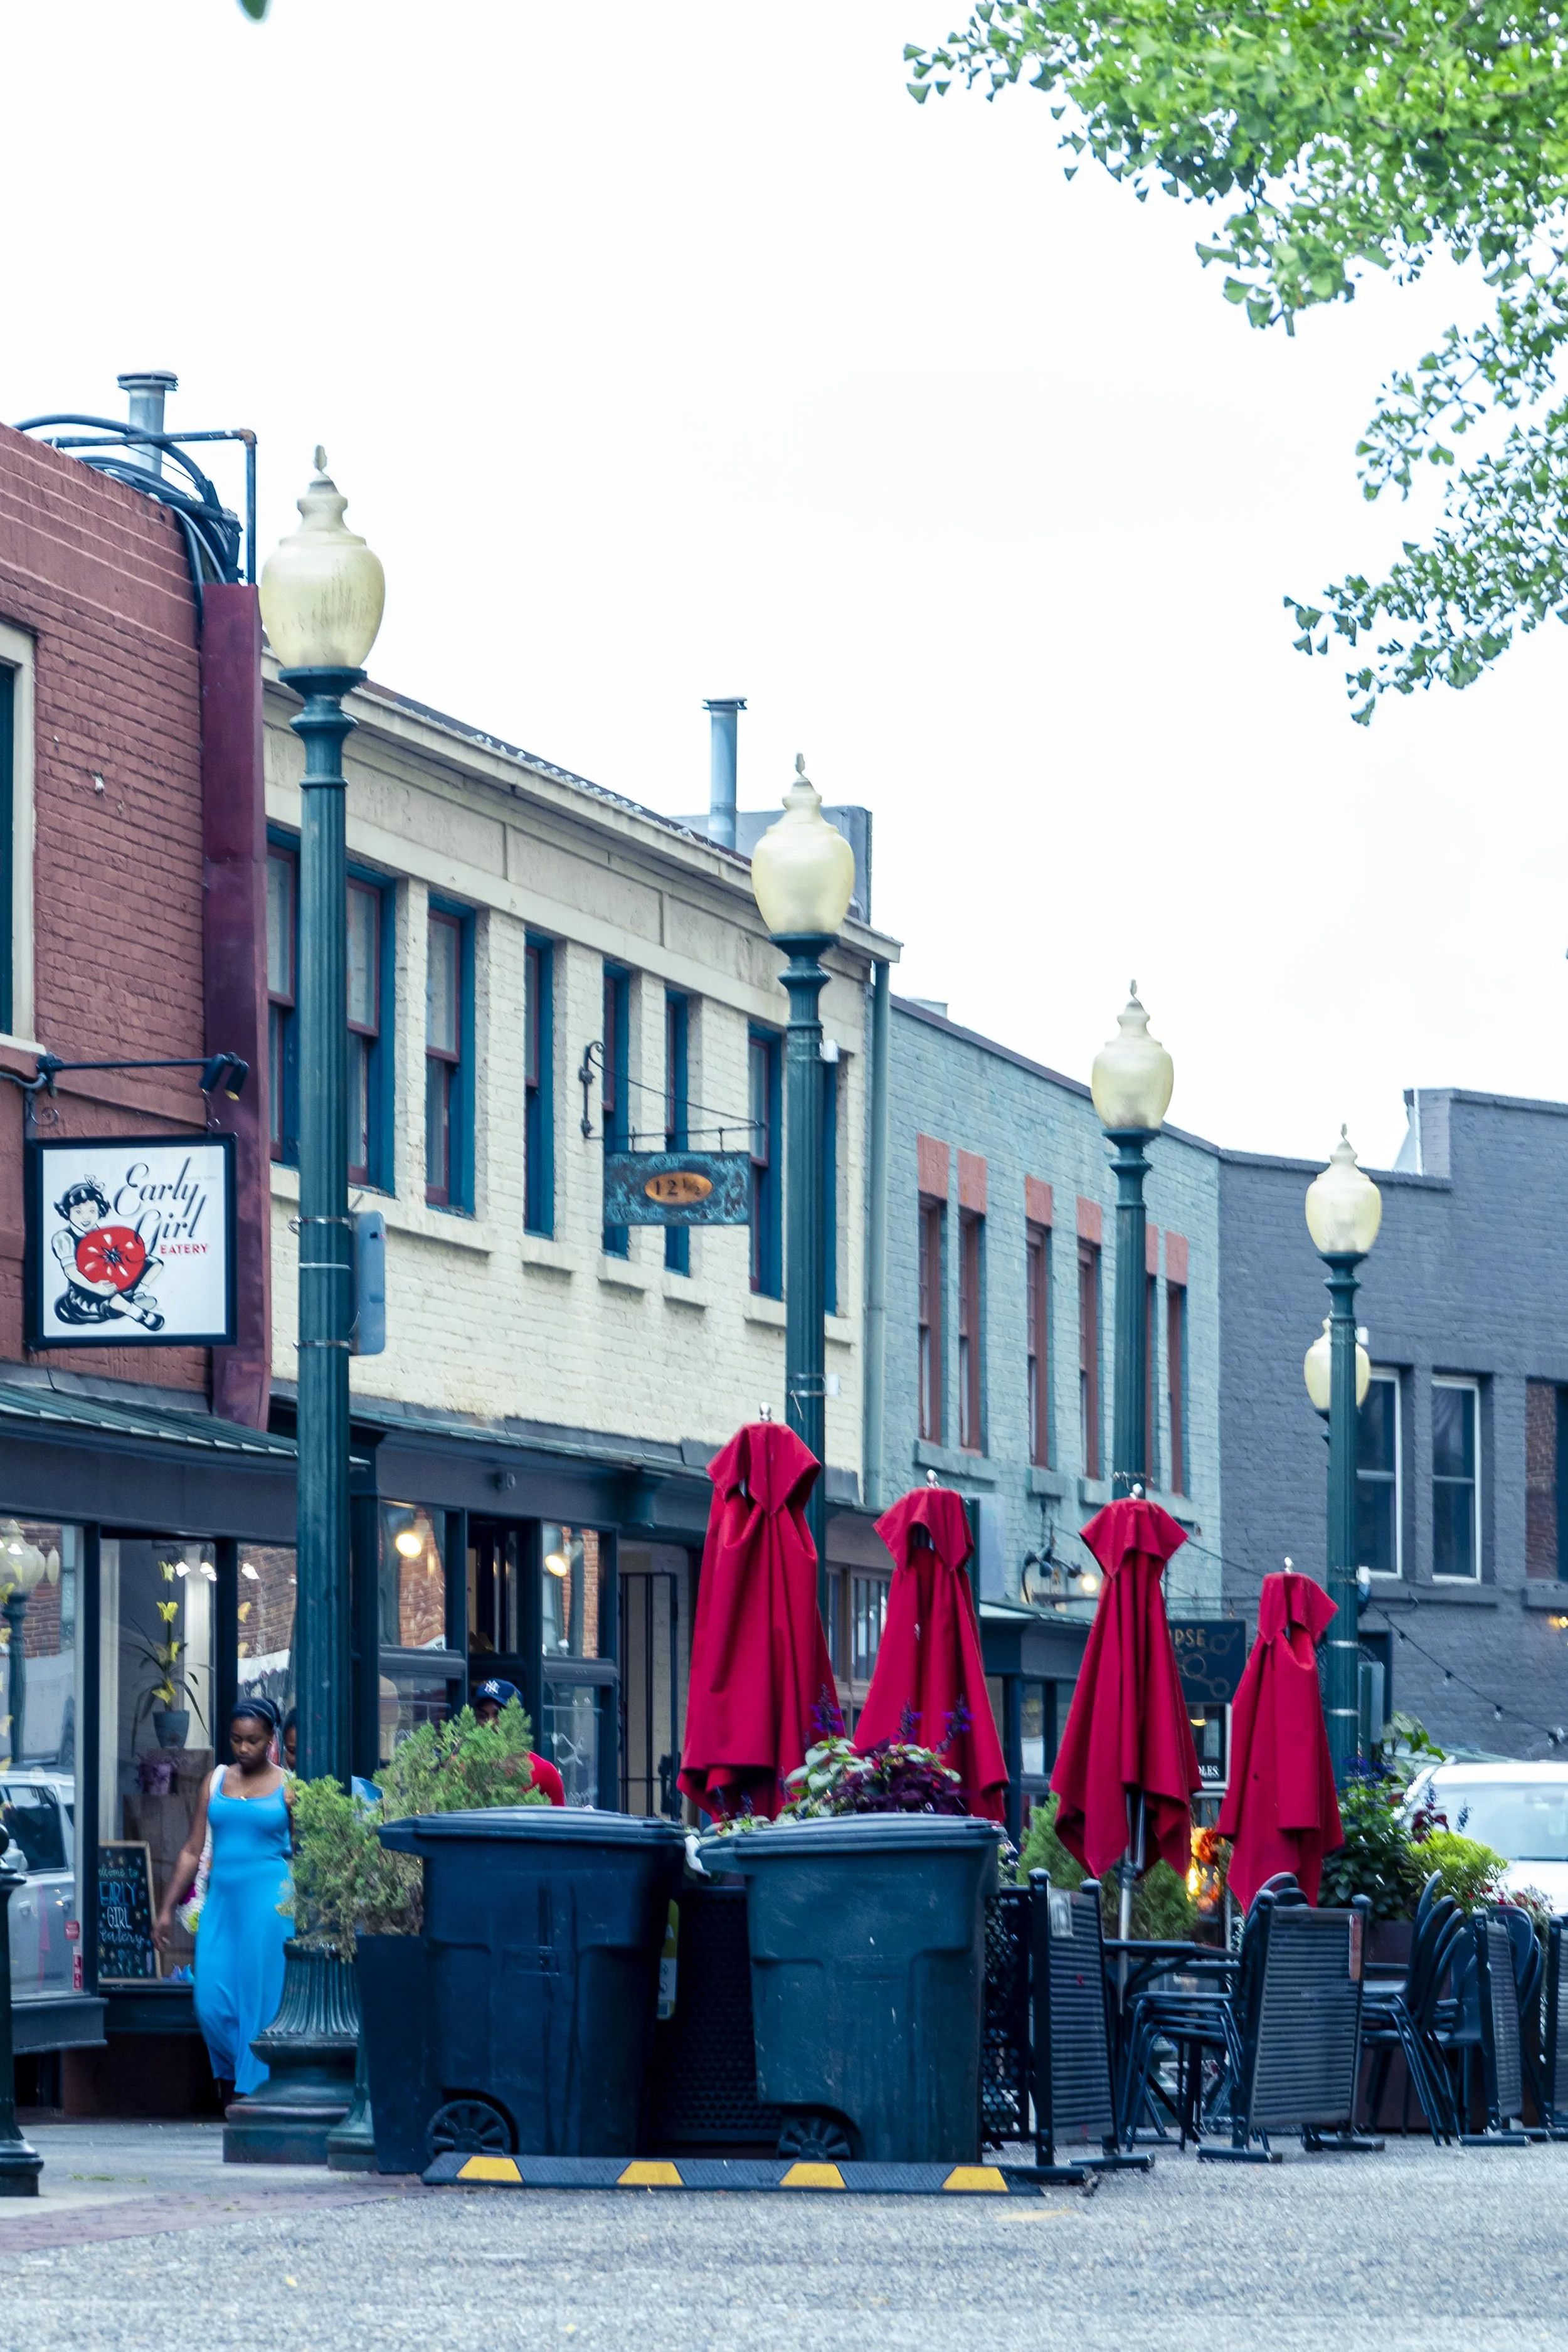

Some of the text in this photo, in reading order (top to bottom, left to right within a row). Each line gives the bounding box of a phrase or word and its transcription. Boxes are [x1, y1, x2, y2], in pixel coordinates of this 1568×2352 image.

[113, 1157, 199, 1217] Early
[126, 1194, 206, 1263] Girl
[160, 1244, 208, 1255] EATERY
[1168, 1629, 1207, 1648] PSE
[99, 1882, 136, 1907] EARLY
[107, 1907, 132, 1930] GIRL
[99, 1929, 145, 1950] eatery
